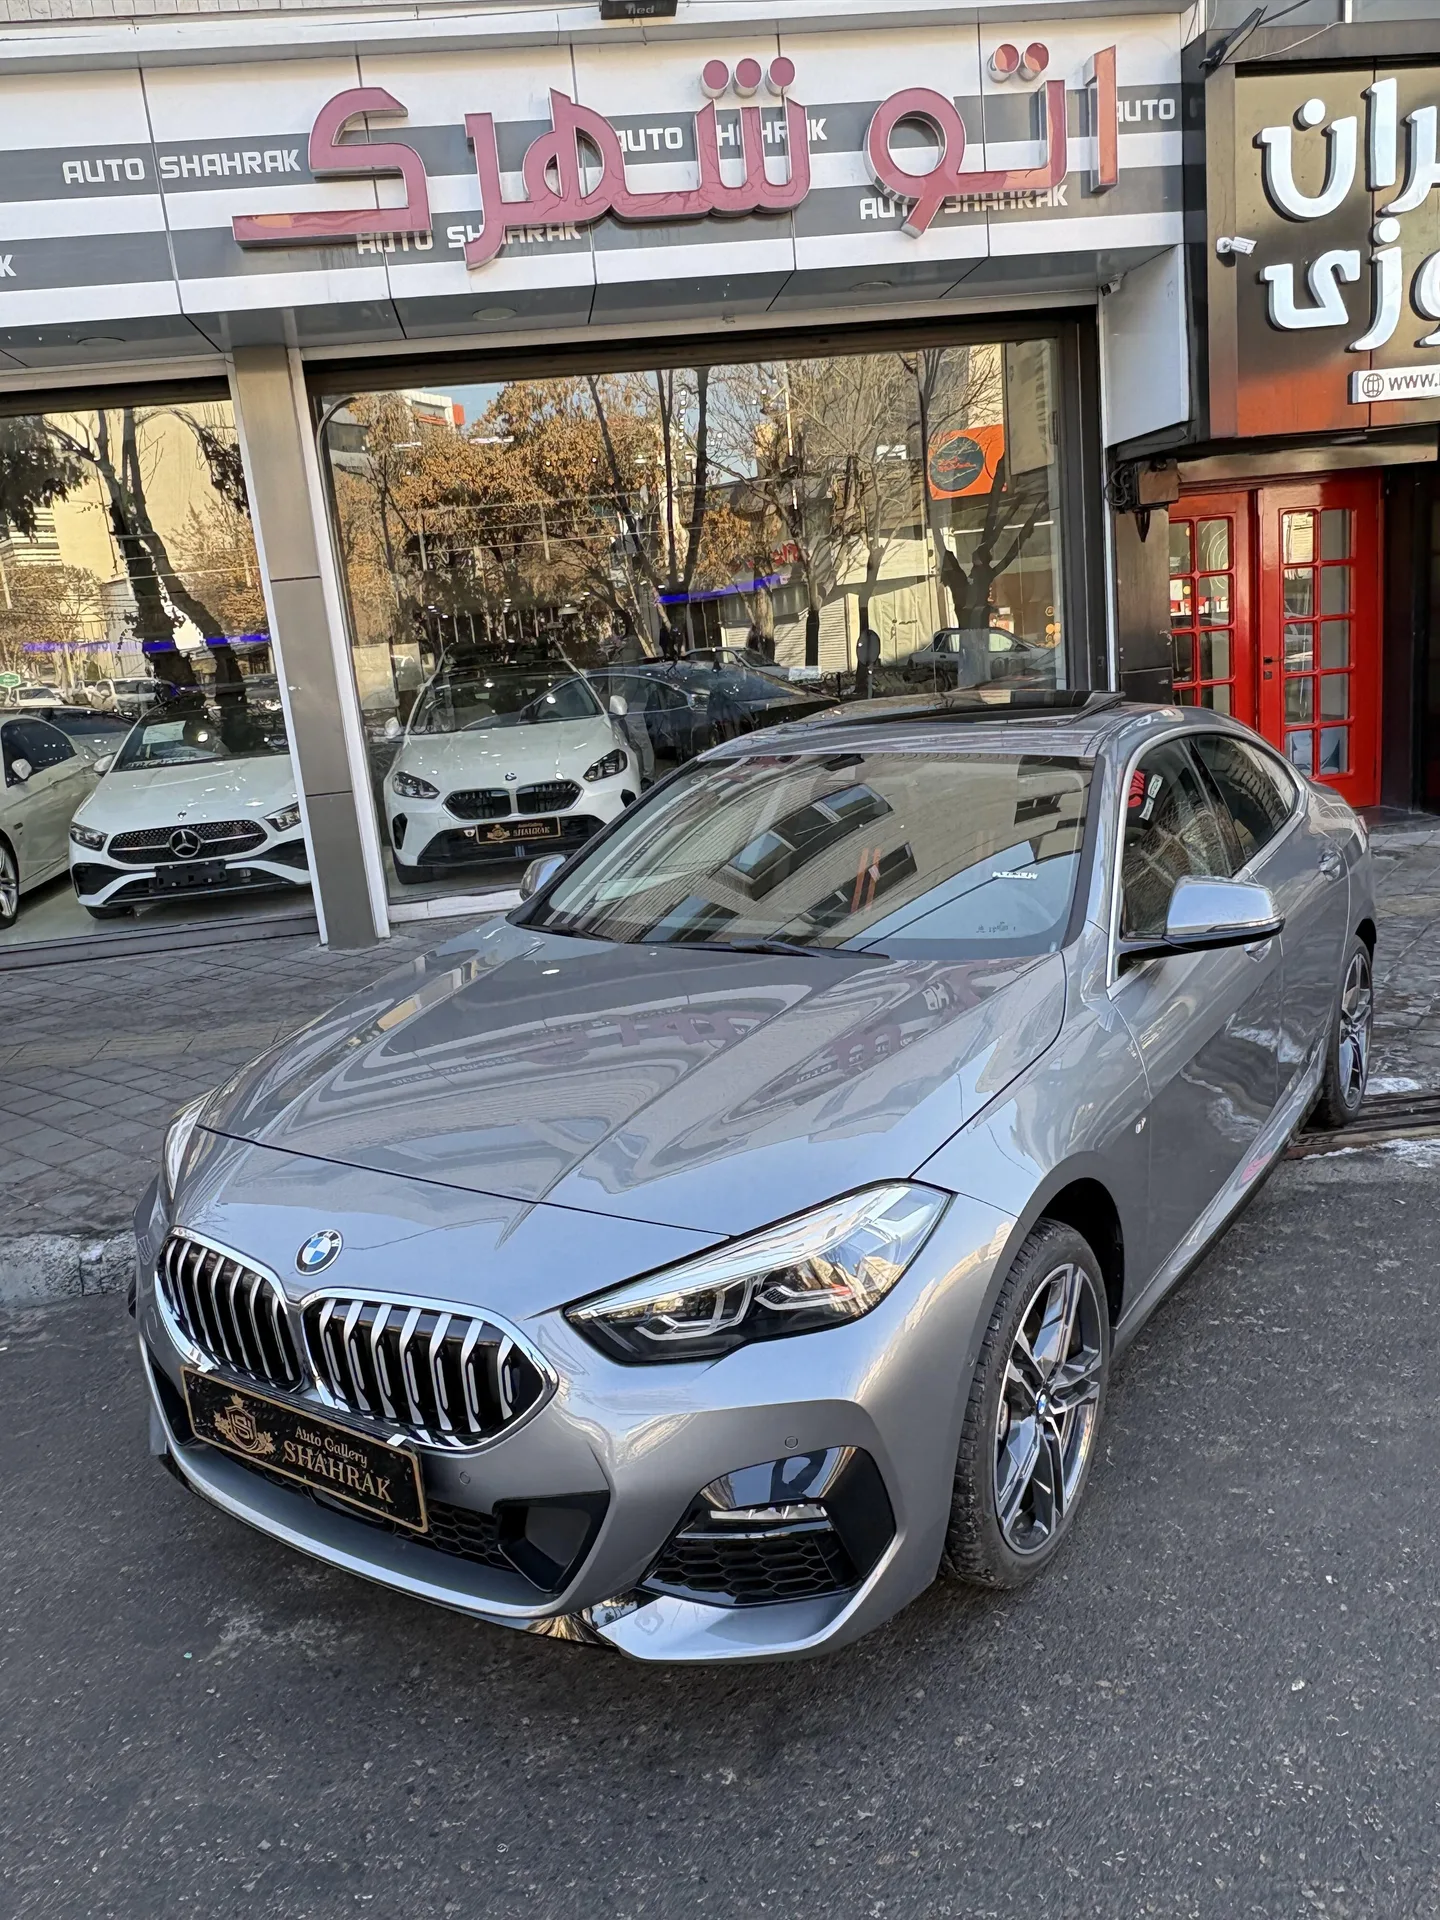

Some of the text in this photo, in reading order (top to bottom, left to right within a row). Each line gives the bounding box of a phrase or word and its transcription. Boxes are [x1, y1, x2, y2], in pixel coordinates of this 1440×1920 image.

[61, 149, 302, 184] AUTO SHAHRAK
[230, 41, 1119, 271] اتو شهرک
[1259, 77, 1440, 218] ران
[1388, 373, 1440, 391] www.
[281, 1440, 394, 1504] SHAHRAK
[294, 1425, 368, 1469] Auto Gallery
